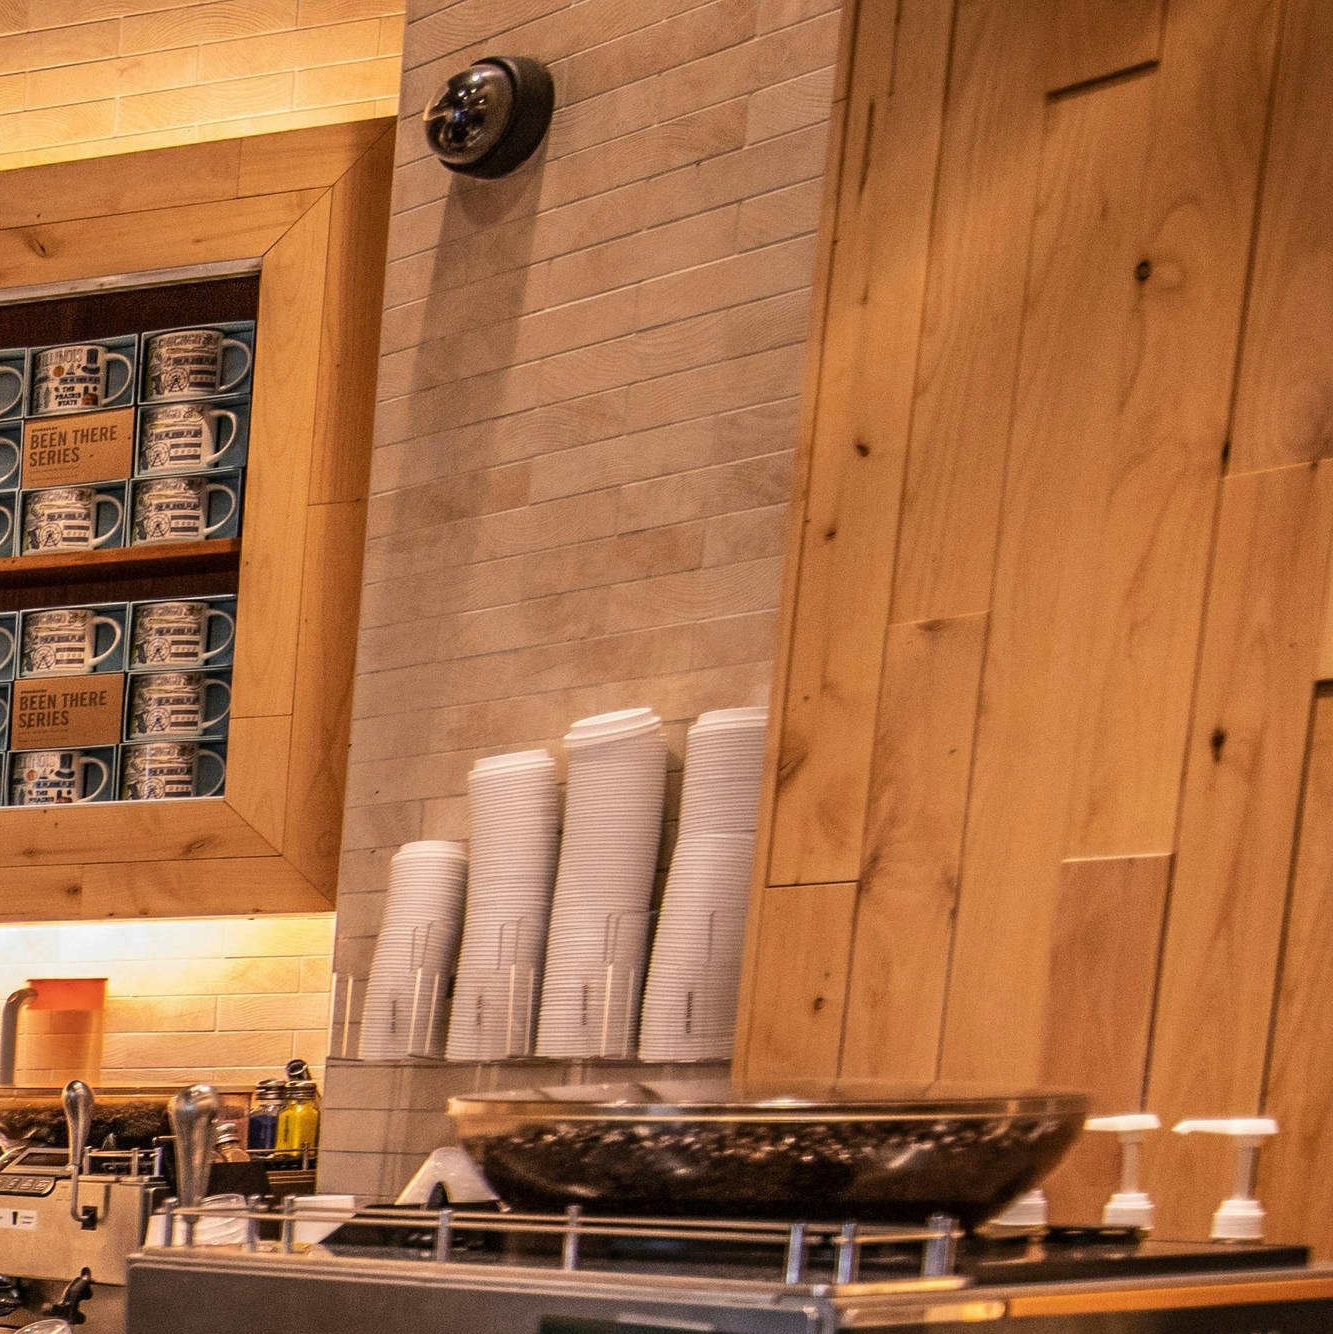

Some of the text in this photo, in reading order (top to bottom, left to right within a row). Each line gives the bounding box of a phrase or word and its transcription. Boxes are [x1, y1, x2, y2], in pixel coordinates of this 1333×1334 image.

[31, 425, 117, 449] BEEN THERE
[30, 448, 80, 466] SERIES
[20, 691, 107, 710] BEEN THERE
[19, 711, 69, 727] SERIES
